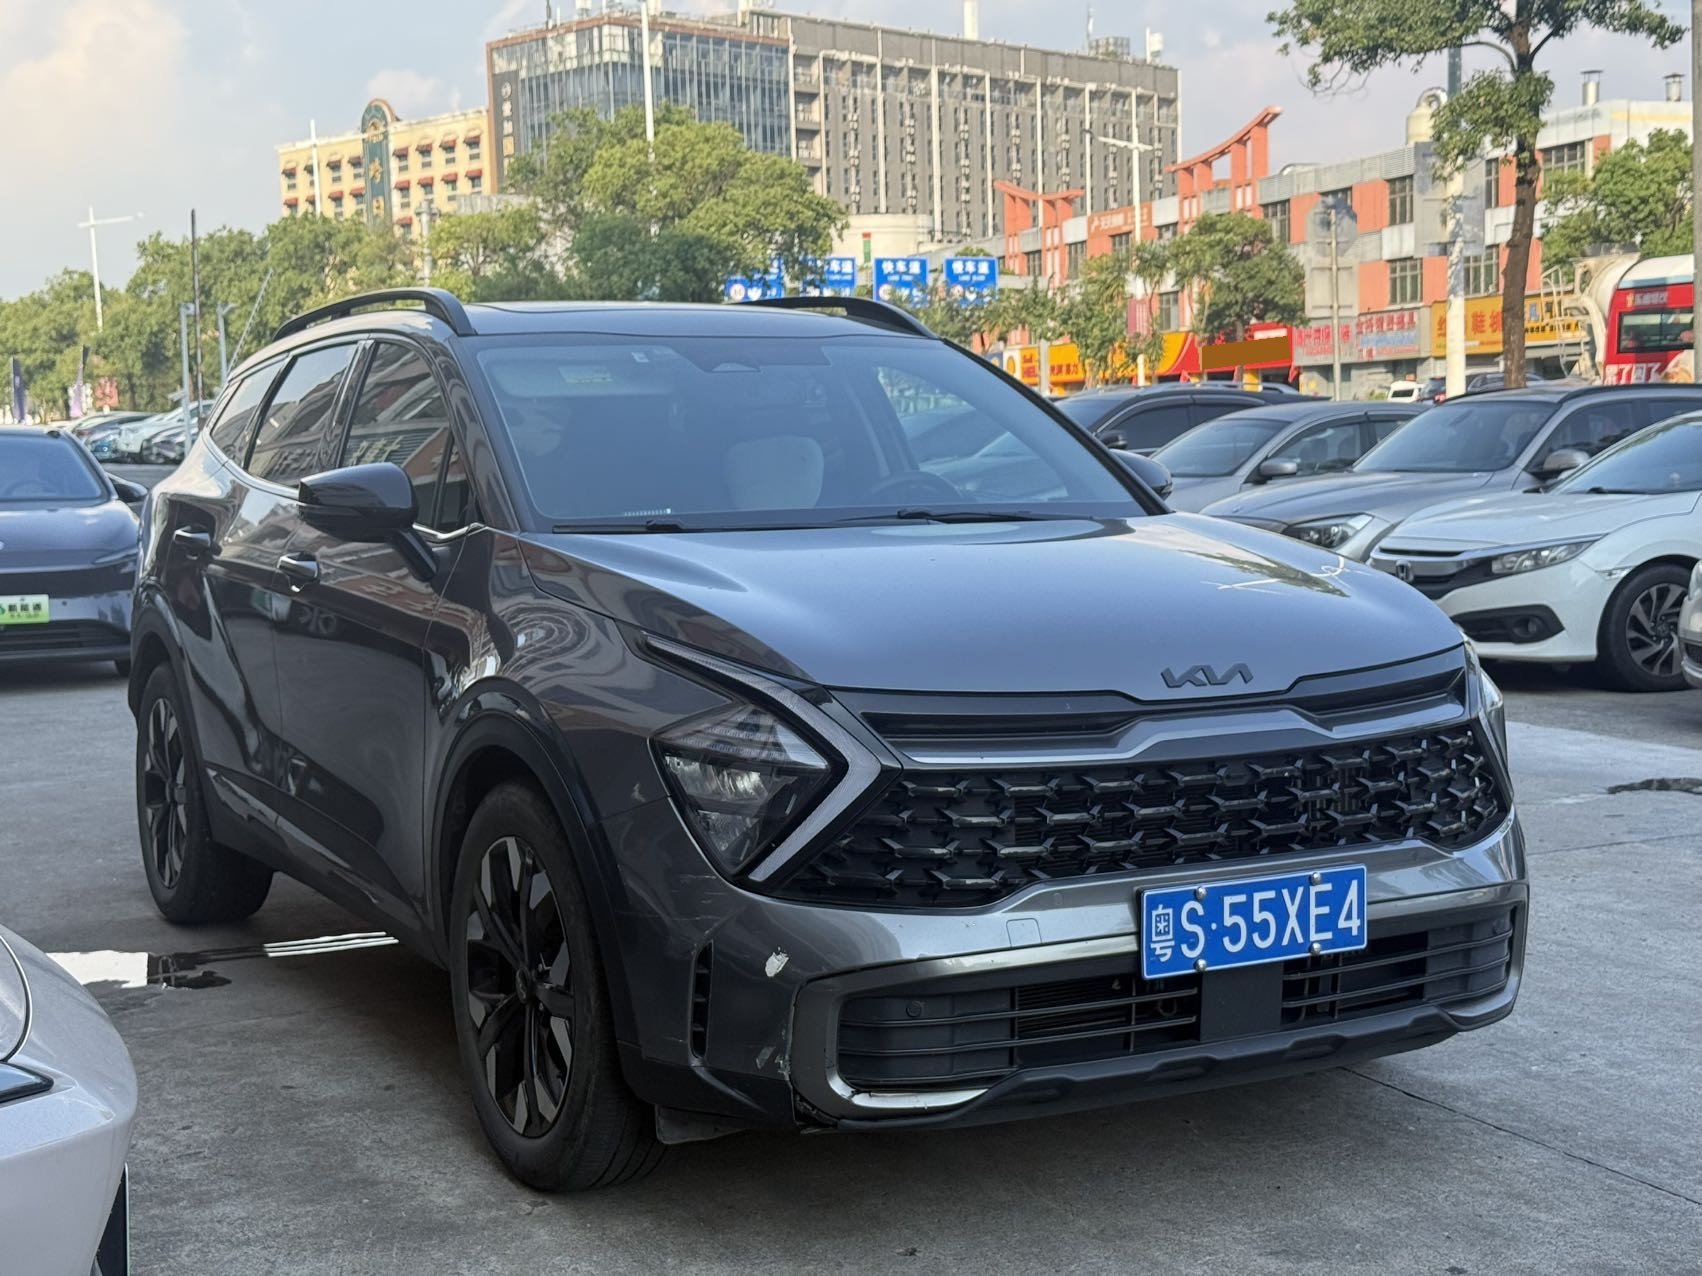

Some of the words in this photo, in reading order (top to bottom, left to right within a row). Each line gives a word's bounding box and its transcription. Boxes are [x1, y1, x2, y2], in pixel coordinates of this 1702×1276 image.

[882, 260, 920, 275] 快车道
[1160, 662, 1254, 689] KIA
[1150, 879, 1361, 962] 粤S·55XE4
